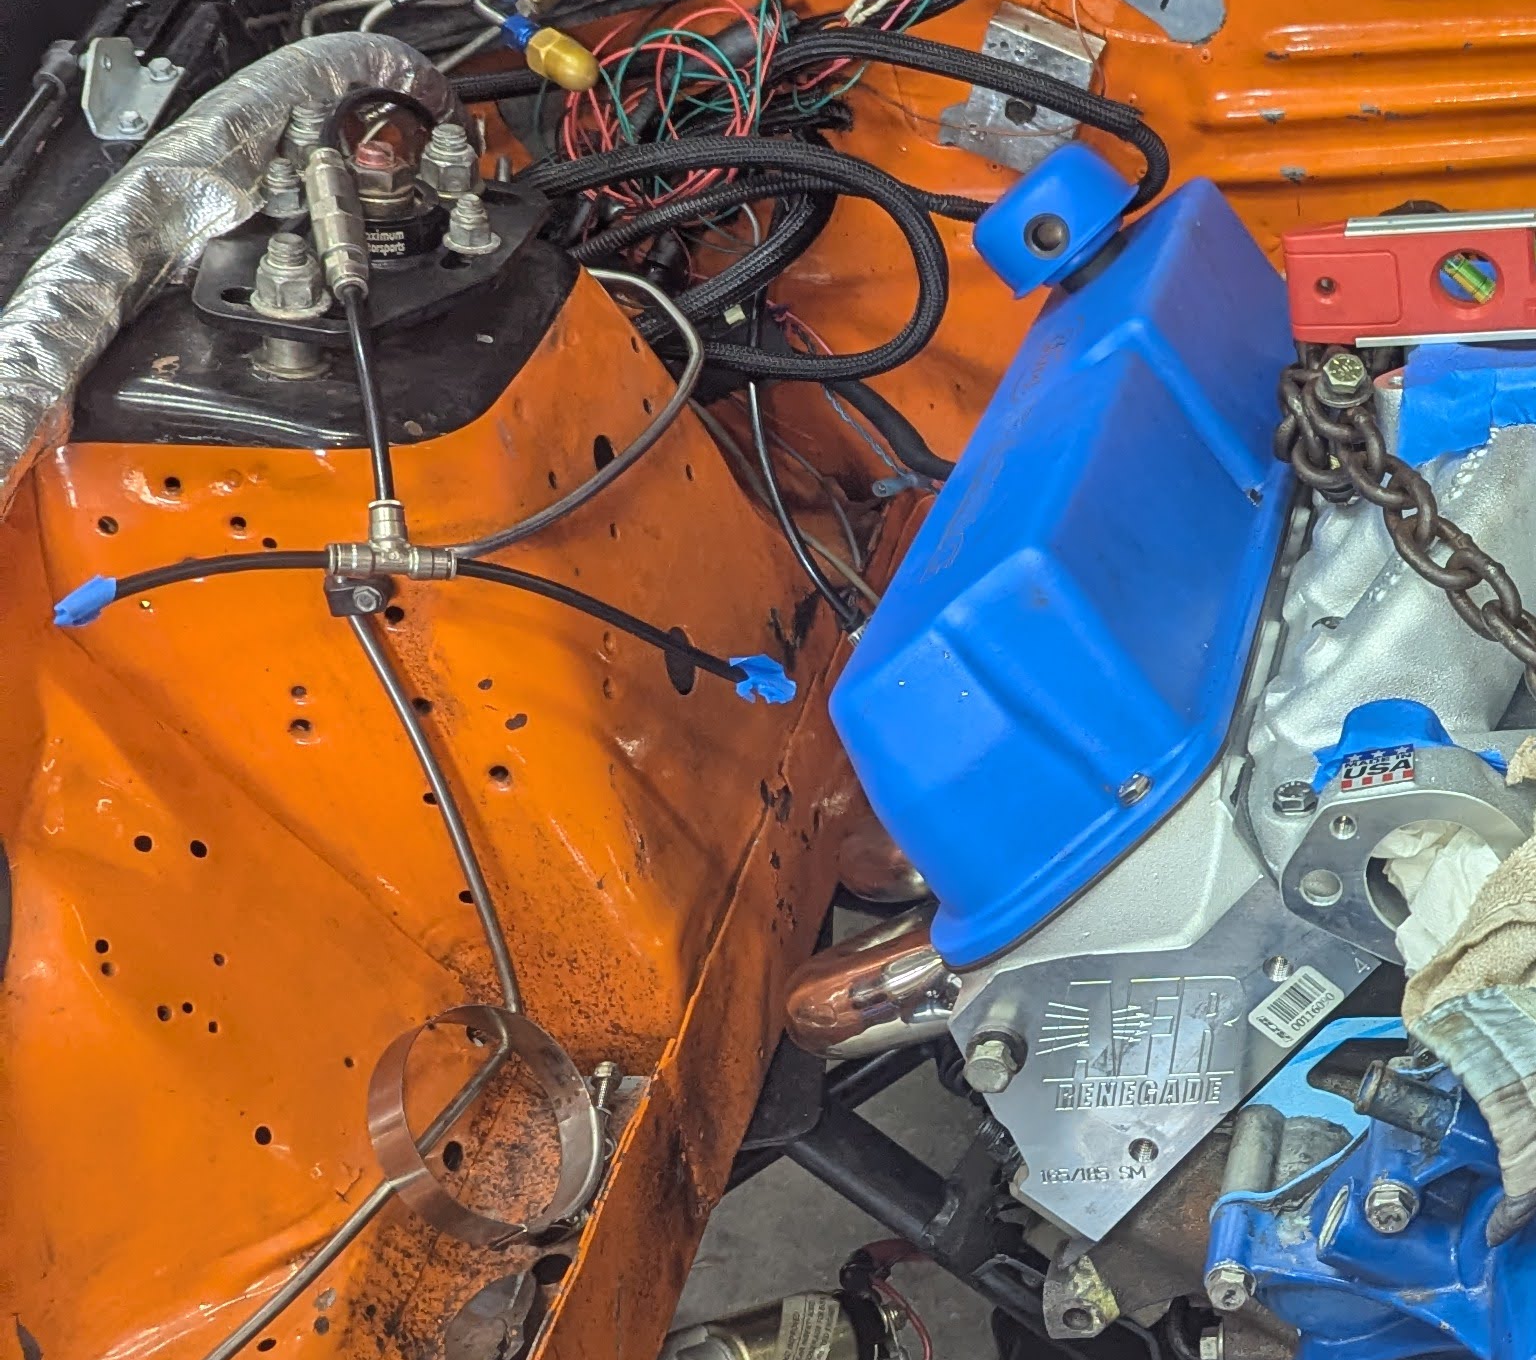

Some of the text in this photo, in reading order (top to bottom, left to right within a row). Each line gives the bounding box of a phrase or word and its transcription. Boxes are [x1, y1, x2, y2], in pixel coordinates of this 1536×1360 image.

[365, 229, 404, 241] ximum
[1344, 751, 1412, 768] MADE IN
[1343, 759, 1412, 779] USA
[1055, 1077, 1222, 1111] RENEGADE
[1118, 1165, 1147, 1180] SM
